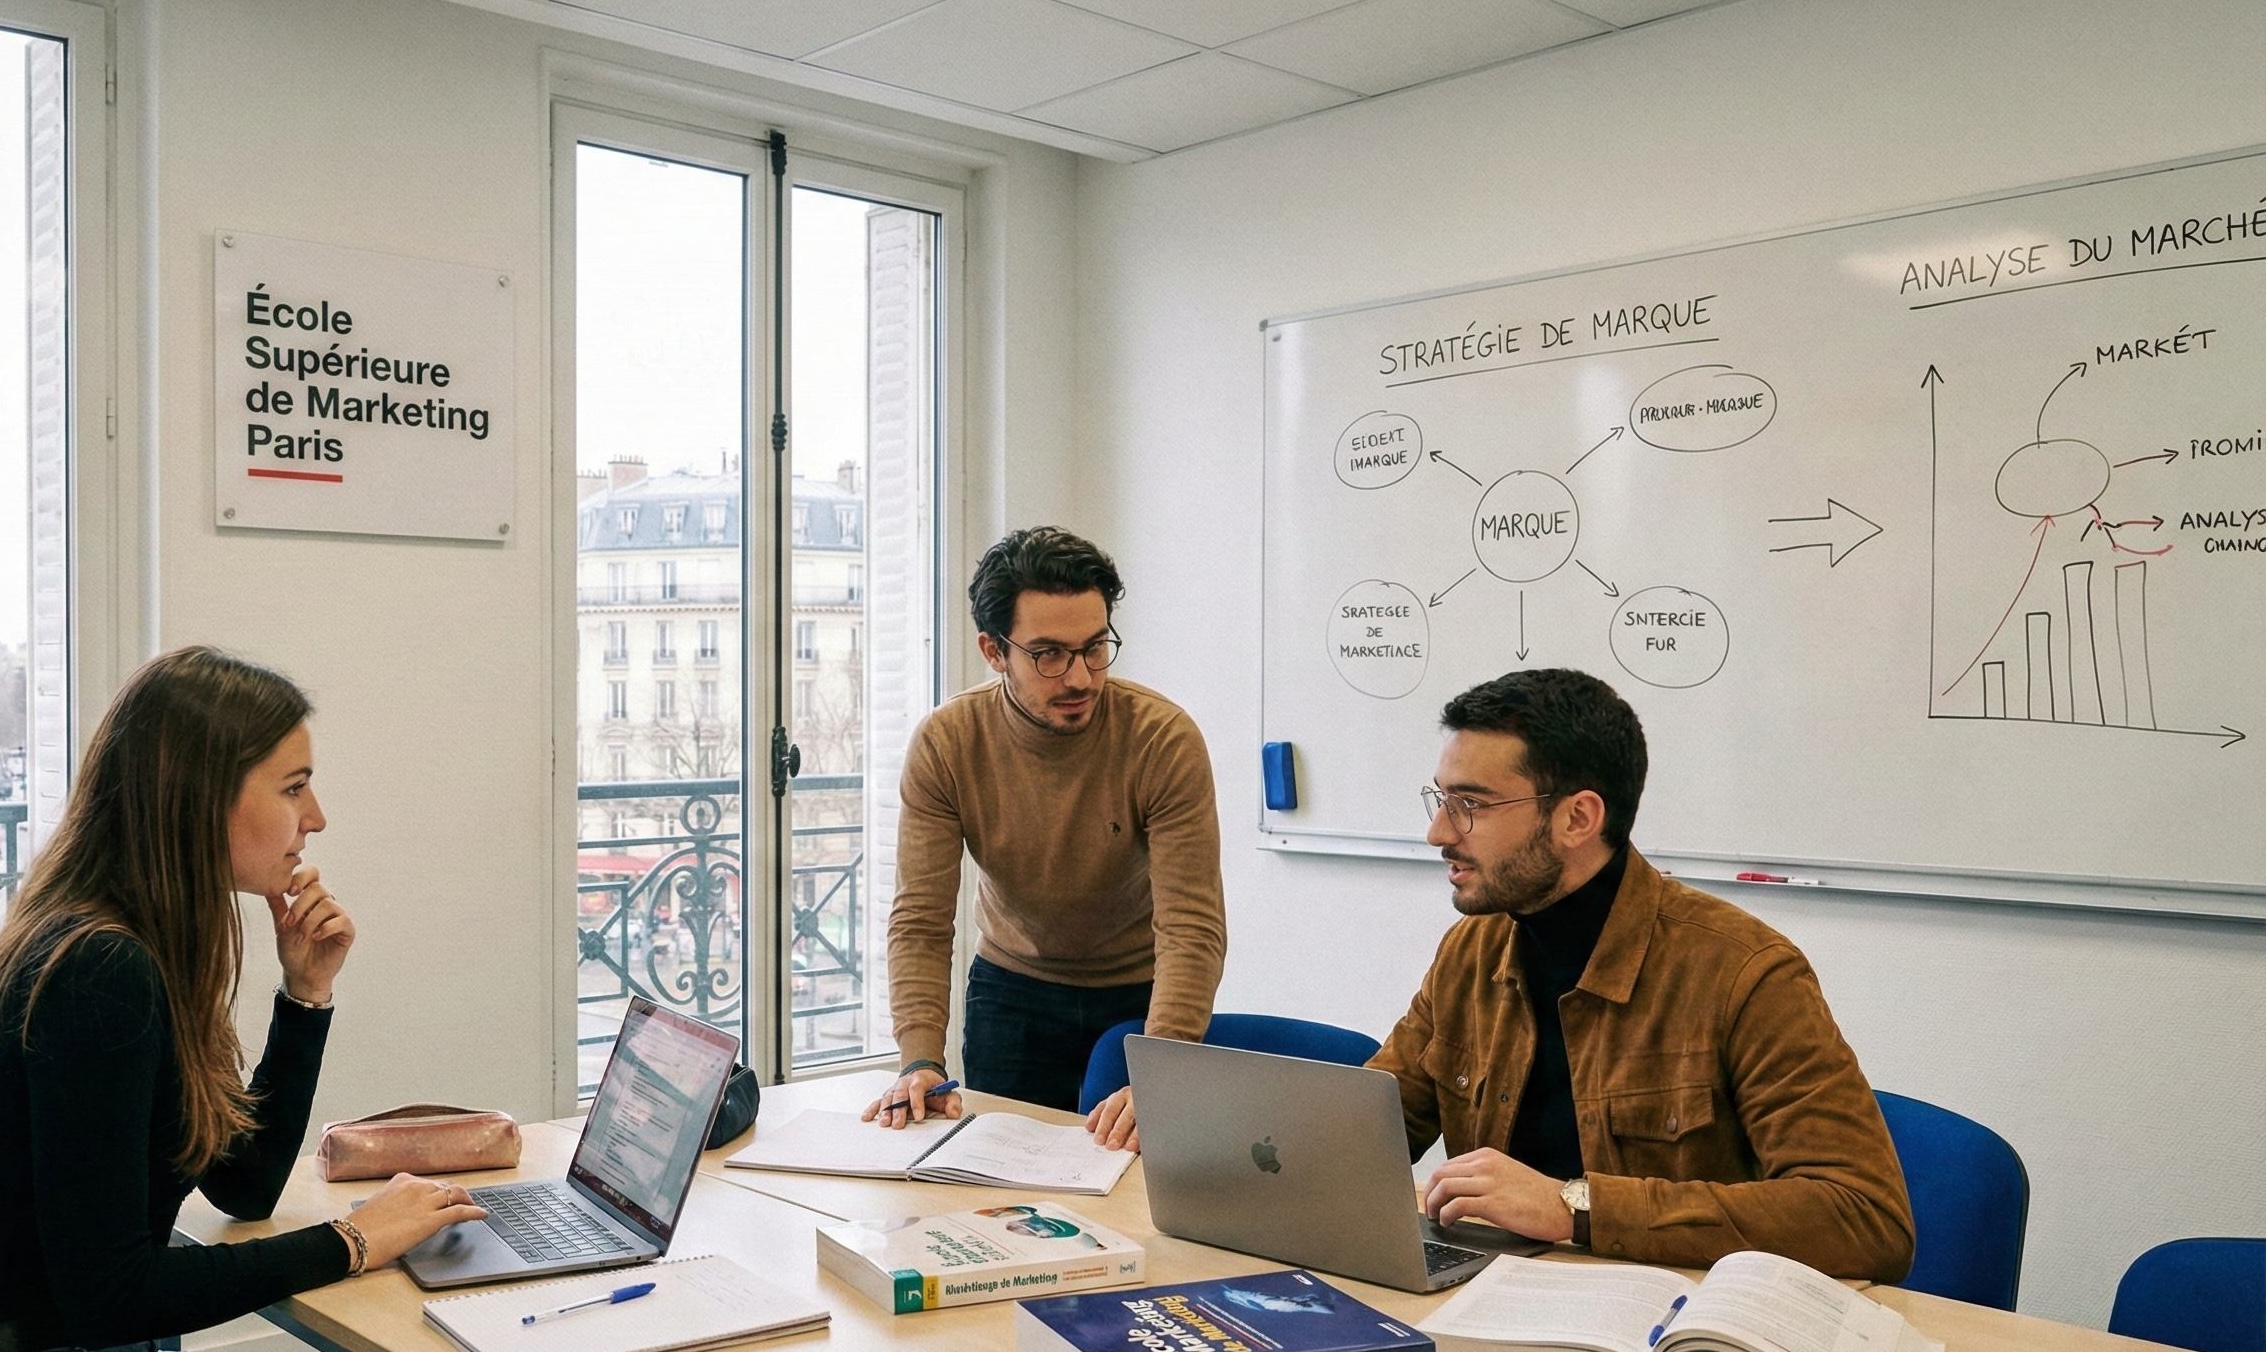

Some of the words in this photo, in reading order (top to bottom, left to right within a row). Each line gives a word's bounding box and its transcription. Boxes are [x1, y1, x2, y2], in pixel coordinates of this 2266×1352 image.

[1900, 244, 2049, 295] ANALYSE
[2068, 235, 2112, 267] DU
[247, 283, 353, 334] École
[1540, 318, 1575, 348] DE
[1593, 294, 1718, 340] MARQUE
[245, 335, 450, 388] Supérieure
[2096, 324, 2216, 365] MARKÉT
[245, 381, 294, 415] de
[307, 385, 489, 440] Marketing
[247, 423, 344, 462] Paris
[1480, 510, 1571, 541] MARQUE
[1366, 626, 1383, 637] DE
[1646, 637, 1677, 651] FUR
